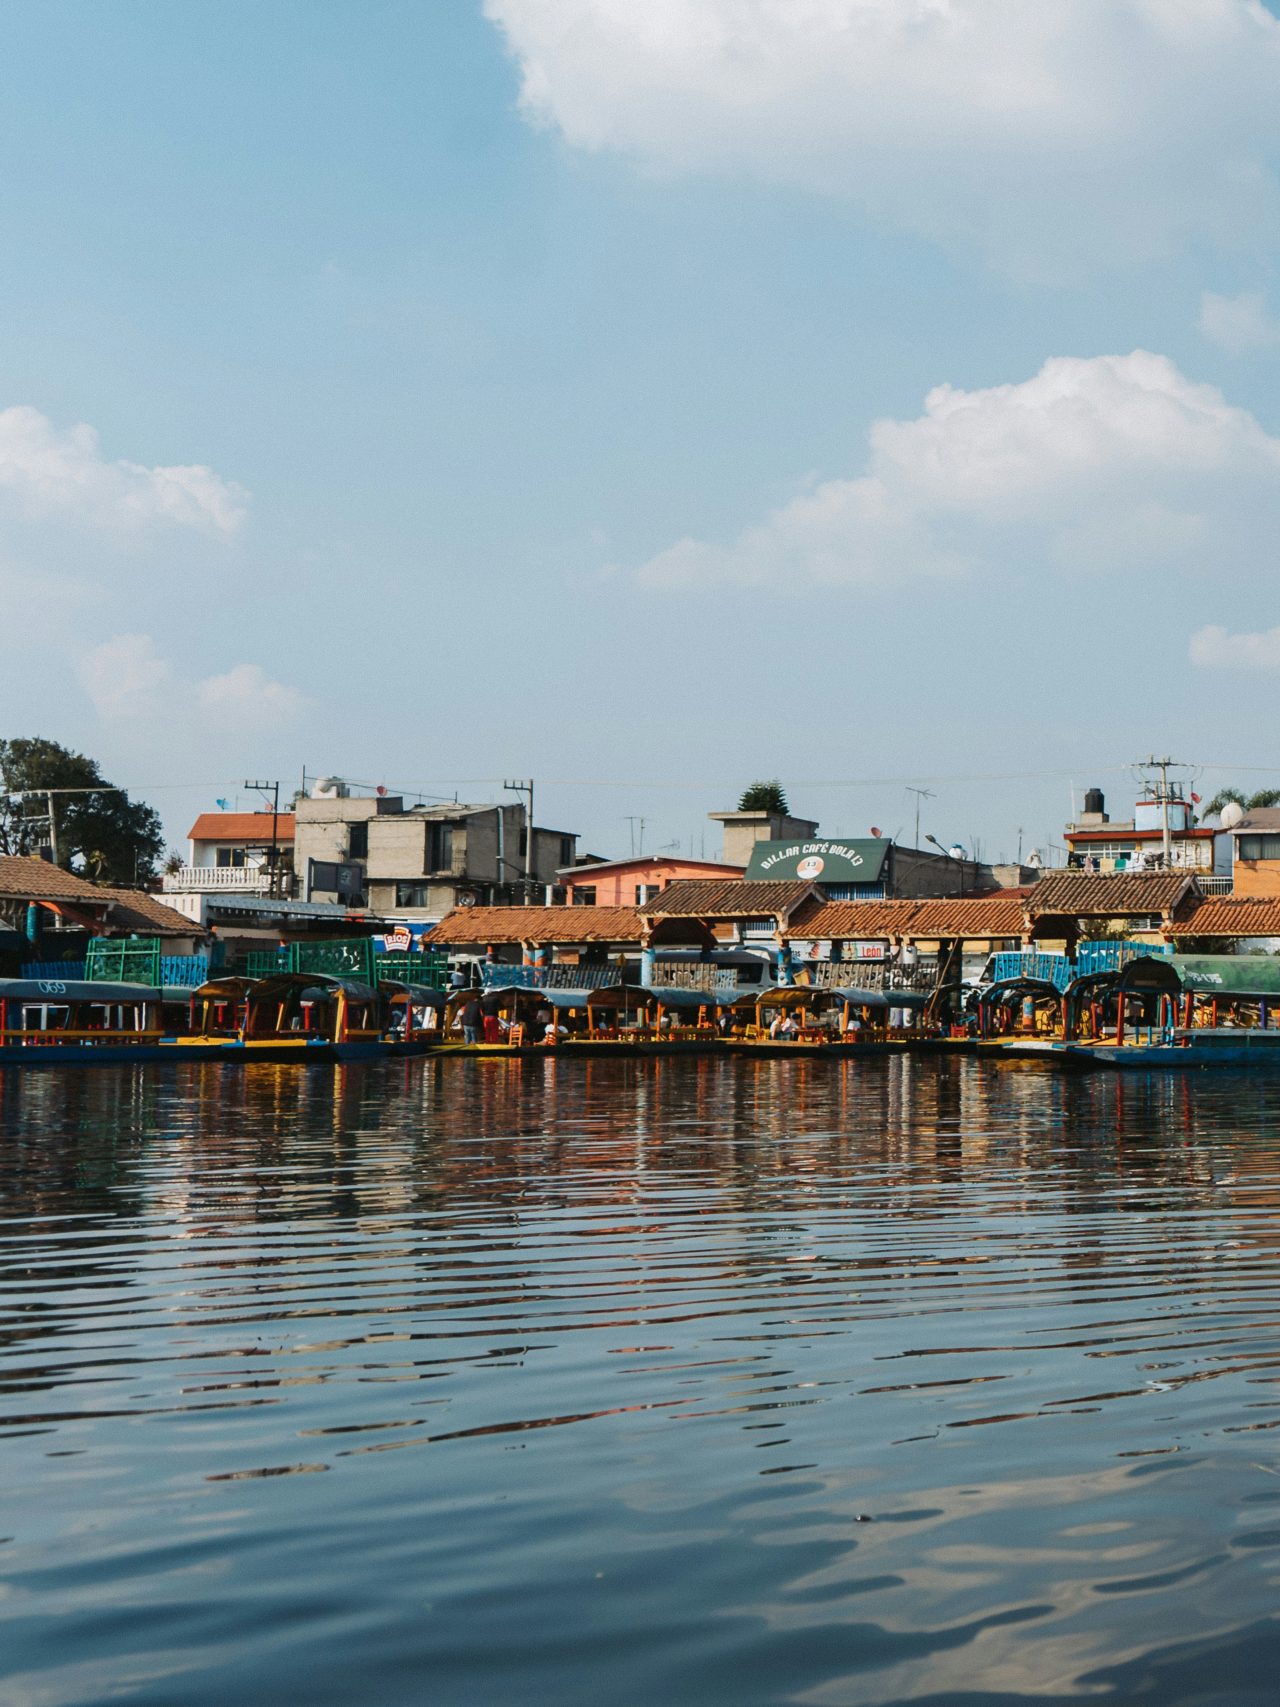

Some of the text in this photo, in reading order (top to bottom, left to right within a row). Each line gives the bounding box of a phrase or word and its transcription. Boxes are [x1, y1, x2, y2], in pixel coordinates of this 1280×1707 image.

[760, 846, 800, 869] BILLAR
[802, 842, 829, 854] CAFÉ
[828, 845, 856, 859] BOLA
[861, 944, 882, 958] León
